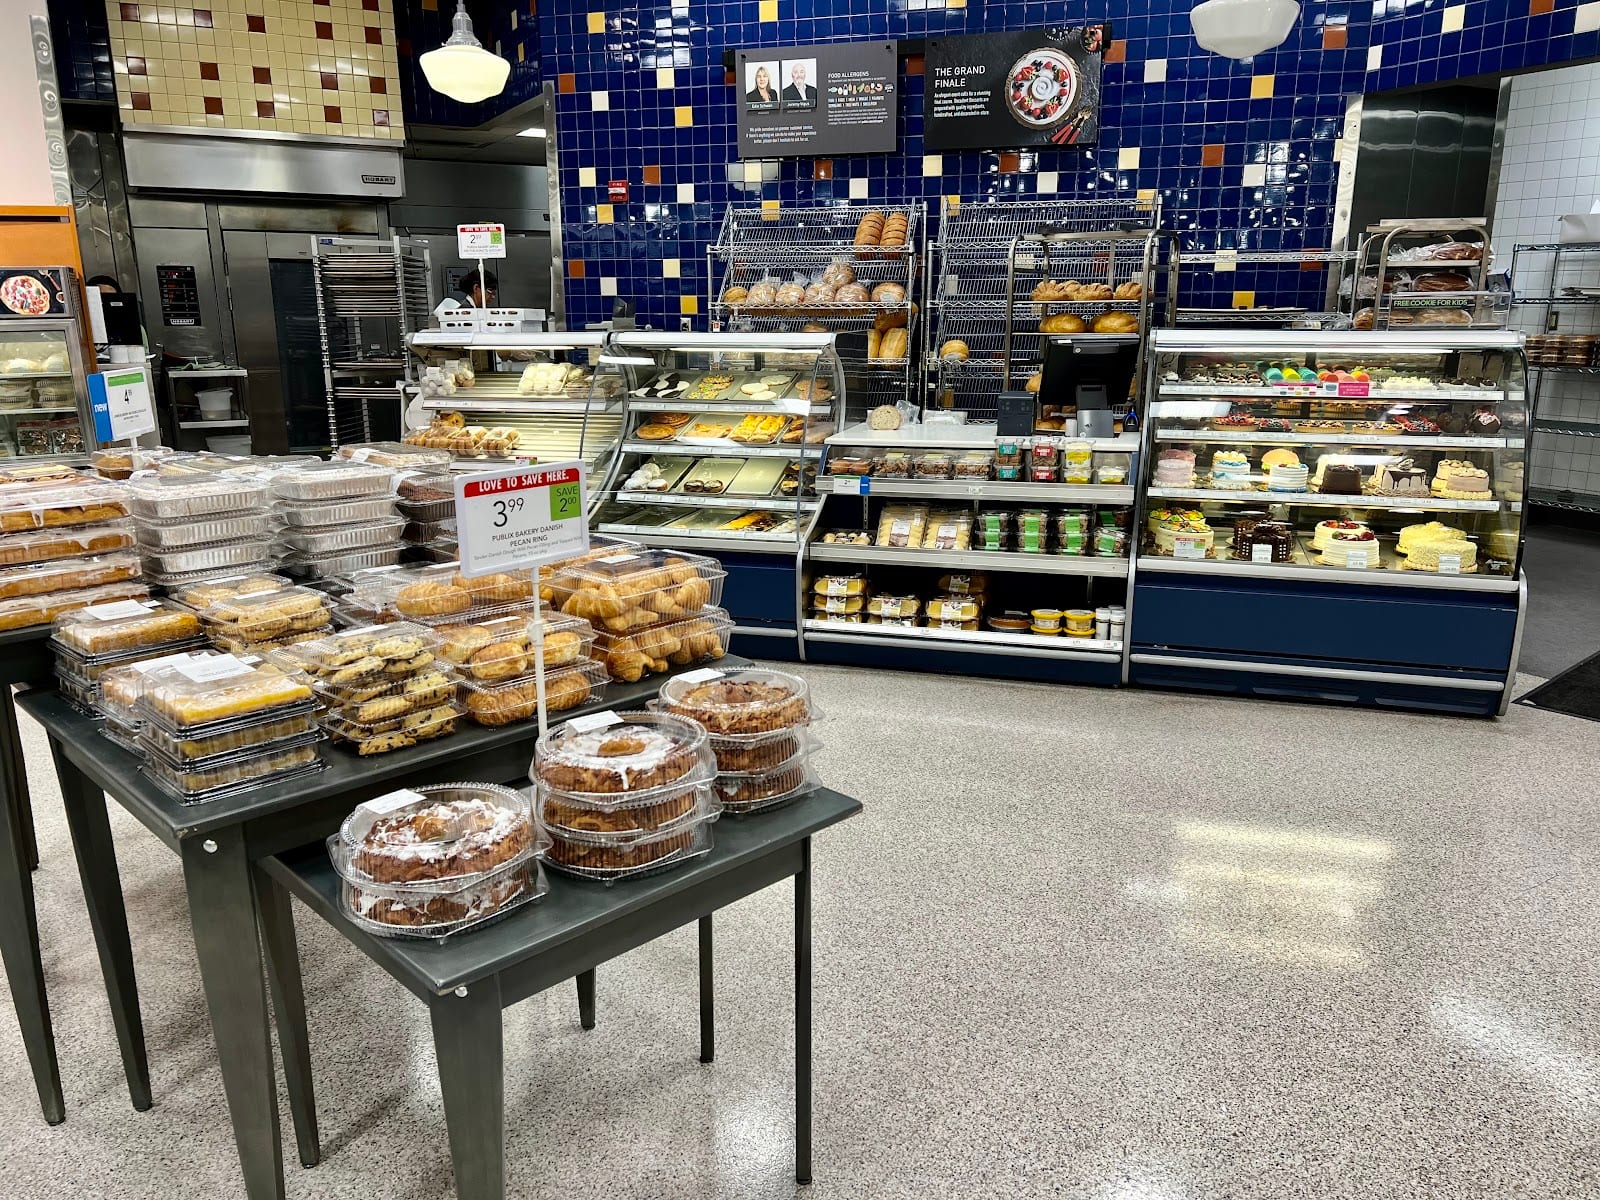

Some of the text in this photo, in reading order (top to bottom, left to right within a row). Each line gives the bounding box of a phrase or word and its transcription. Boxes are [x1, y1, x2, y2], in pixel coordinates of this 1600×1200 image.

[935, 66, 985, 76] THE GRAND
[935, 78, 966, 88] FINALE
[94, 403, 107, 413] new
[479, 470, 569, 492] LOVE TO SAVE HERE.
[556, 486, 578, 496] SAVE
[492, 523, 563, 542] PUBLIX BAKERY DANISH
[510, 535, 548, 547] PECAN RING
